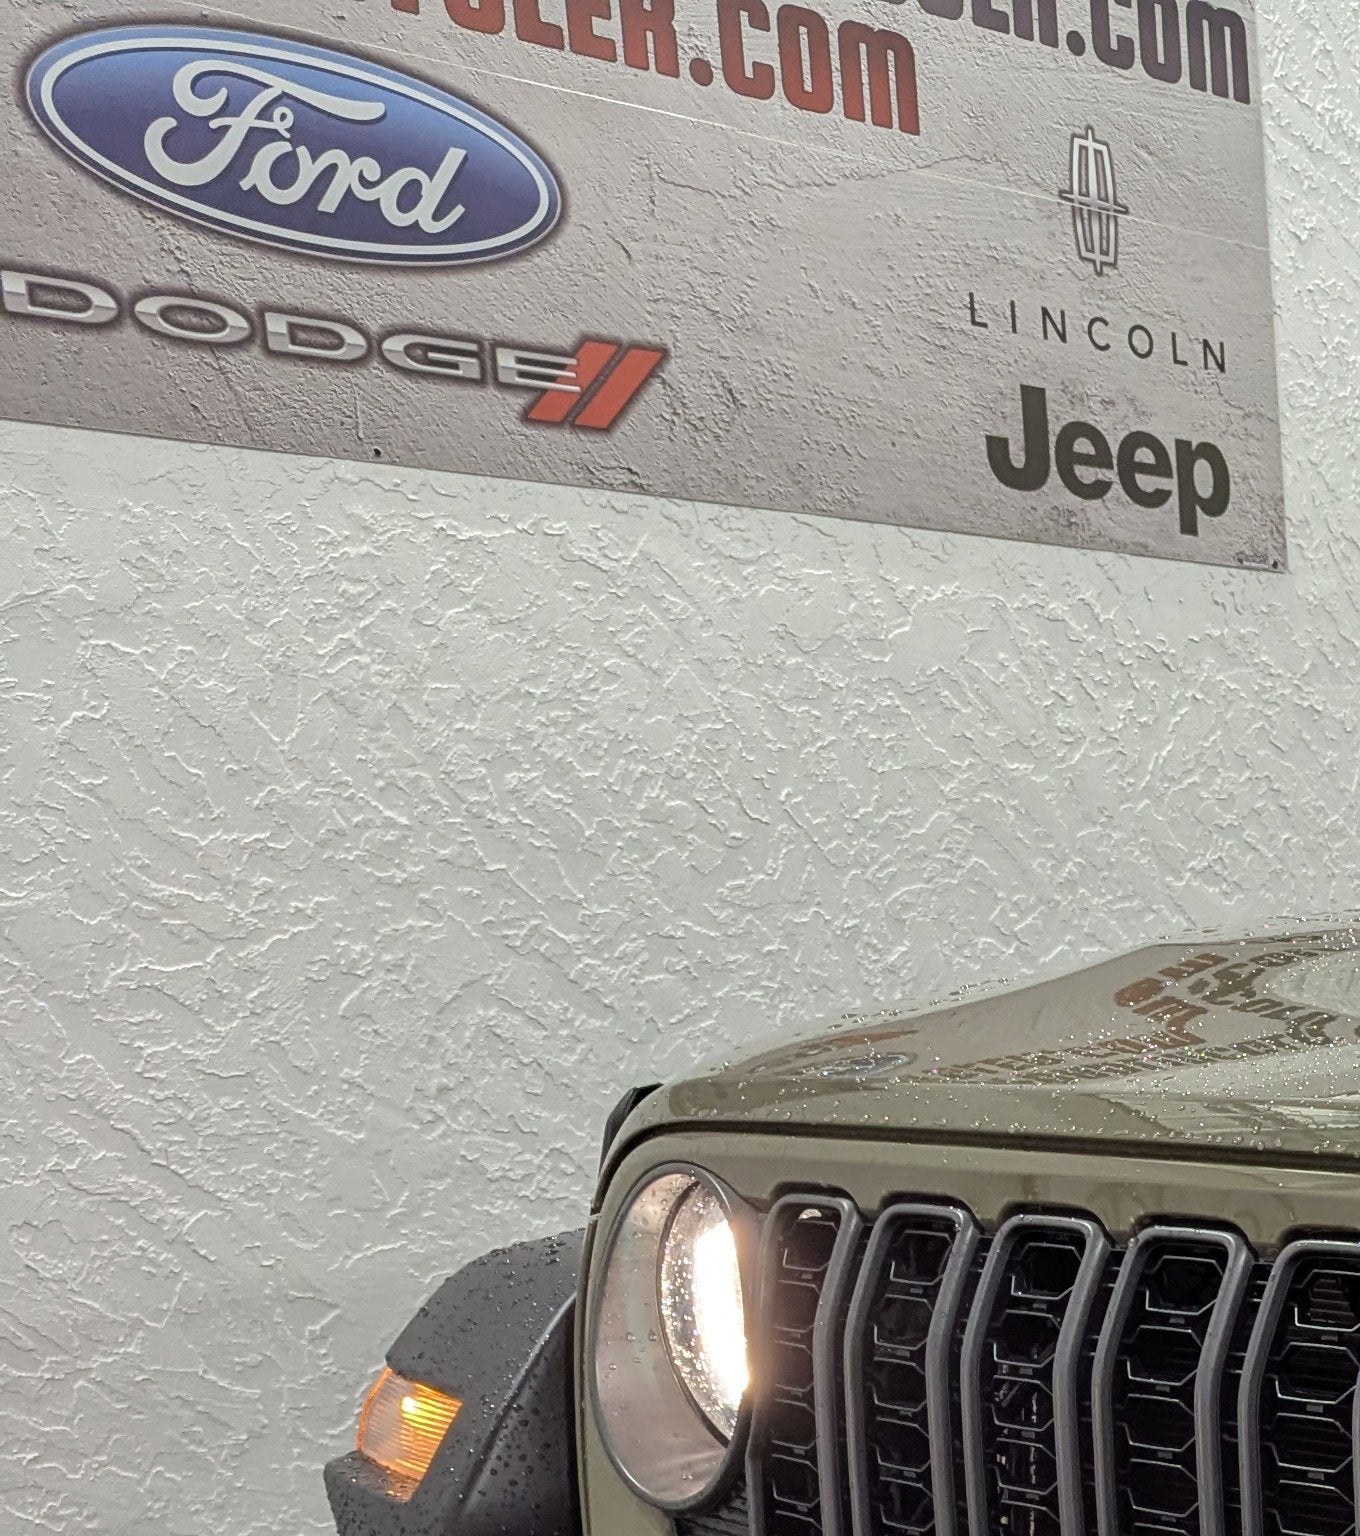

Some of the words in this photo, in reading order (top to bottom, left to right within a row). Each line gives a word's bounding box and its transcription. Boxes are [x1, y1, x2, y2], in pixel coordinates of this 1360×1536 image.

[143, 60, 468, 234] Ford
[0, 269, 581, 394] DODGE
[968, 291, 1226, 374] LINCOLN
[985, 383, 1231, 537] Jeep
